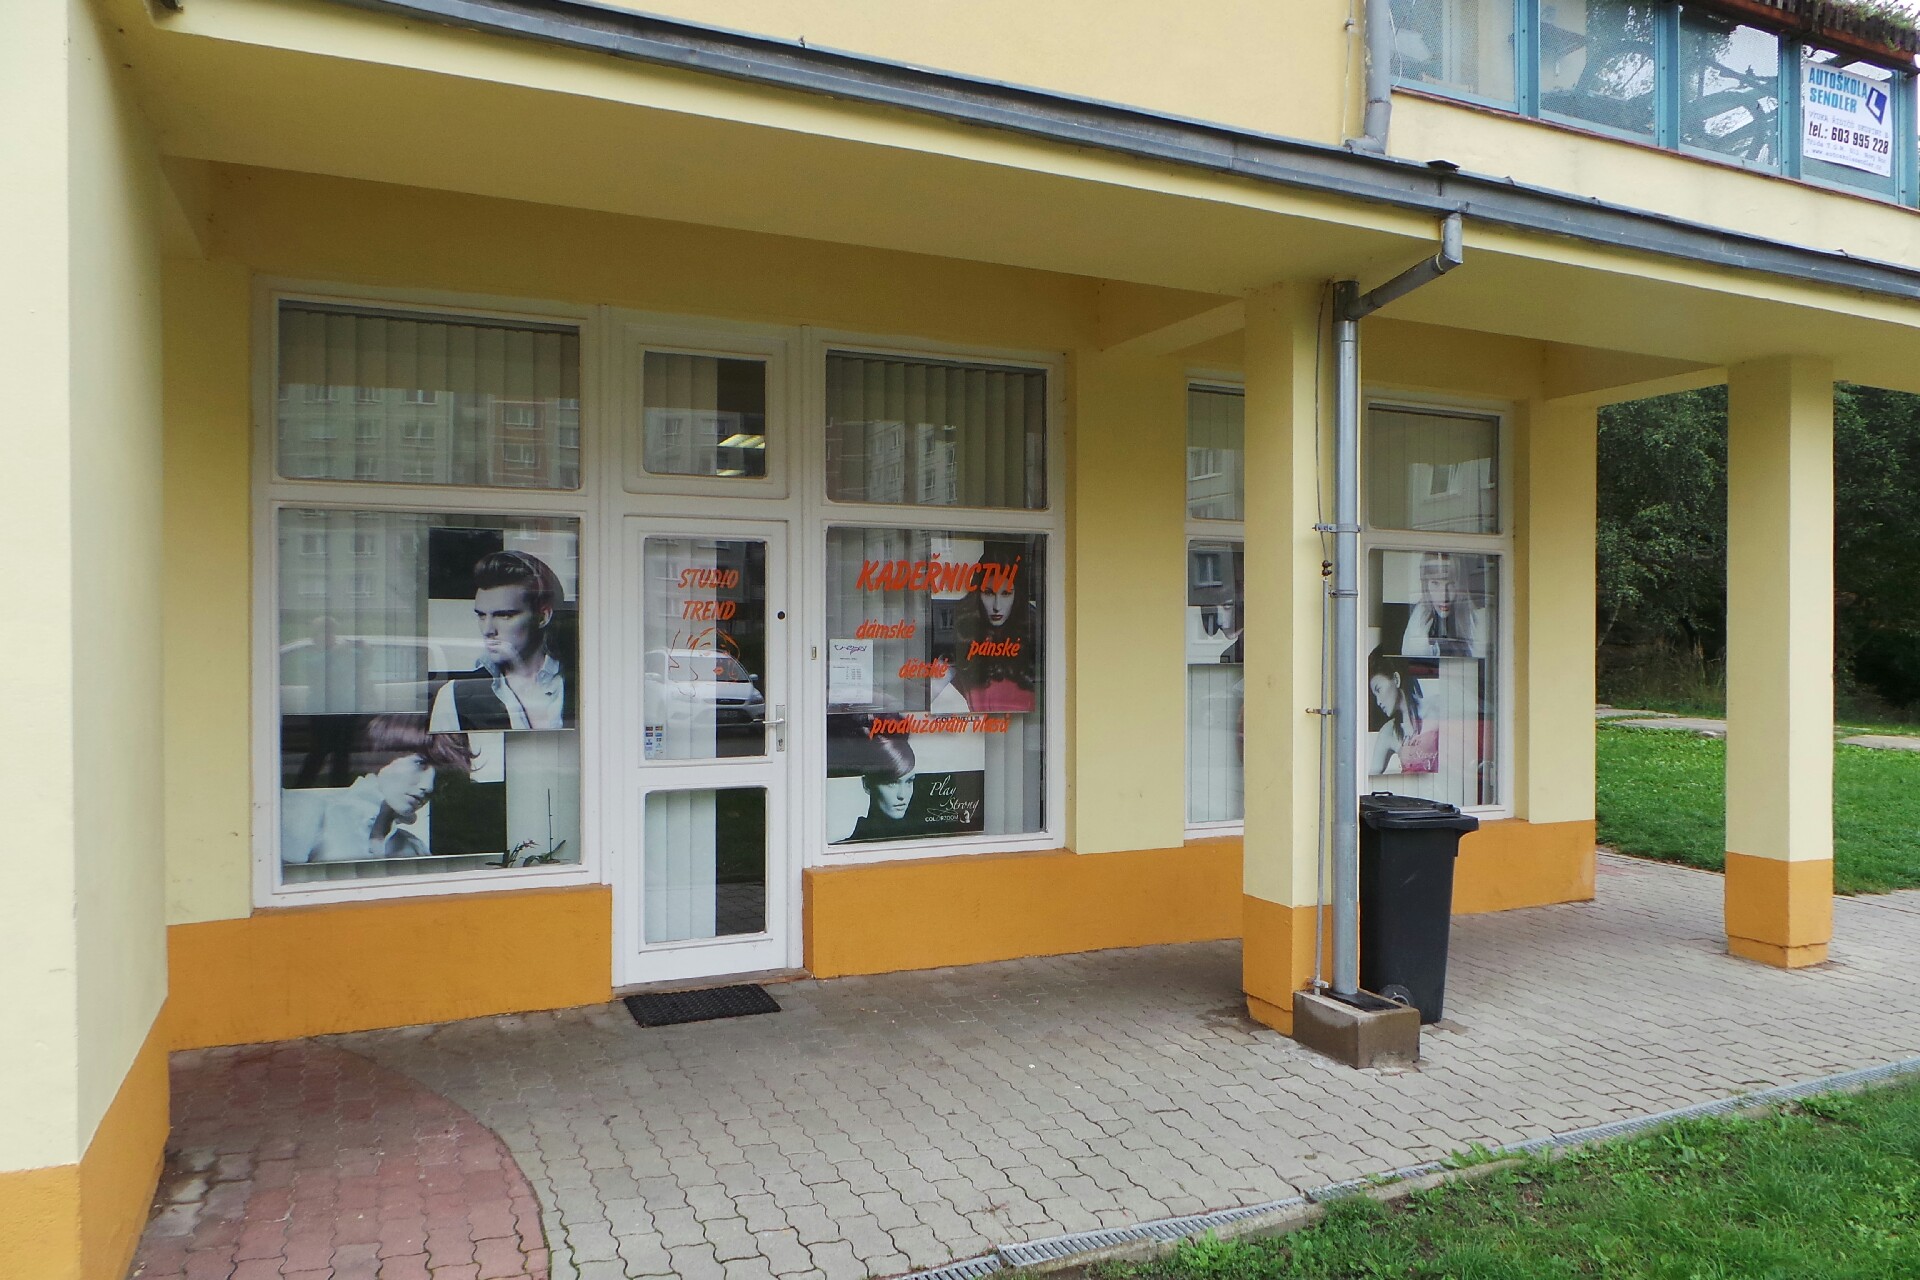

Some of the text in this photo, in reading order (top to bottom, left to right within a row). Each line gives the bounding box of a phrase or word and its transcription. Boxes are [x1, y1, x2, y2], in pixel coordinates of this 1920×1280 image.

[1808, 67, 1867, 99] AUTOŠKOLA
[1809, 87, 1857, 113] SENDLER
[1808, 121, 1828, 139] tel.:
[1831, 126, 1850, 144] 603
[1853, 132, 1870, 149] 995
[1872, 137, 1889, 155] 228
[678, 569, 739, 589] STUDIO
[856, 553, 1021, 594] KADEŘNICTVÍ
[682, 600, 737, 621] TREND
[855, 617, 916, 640] dámské
[967, 637, 1021, 660] pánské
[898, 658, 949, 679] dětské
[930, 775, 957, 805] Play
